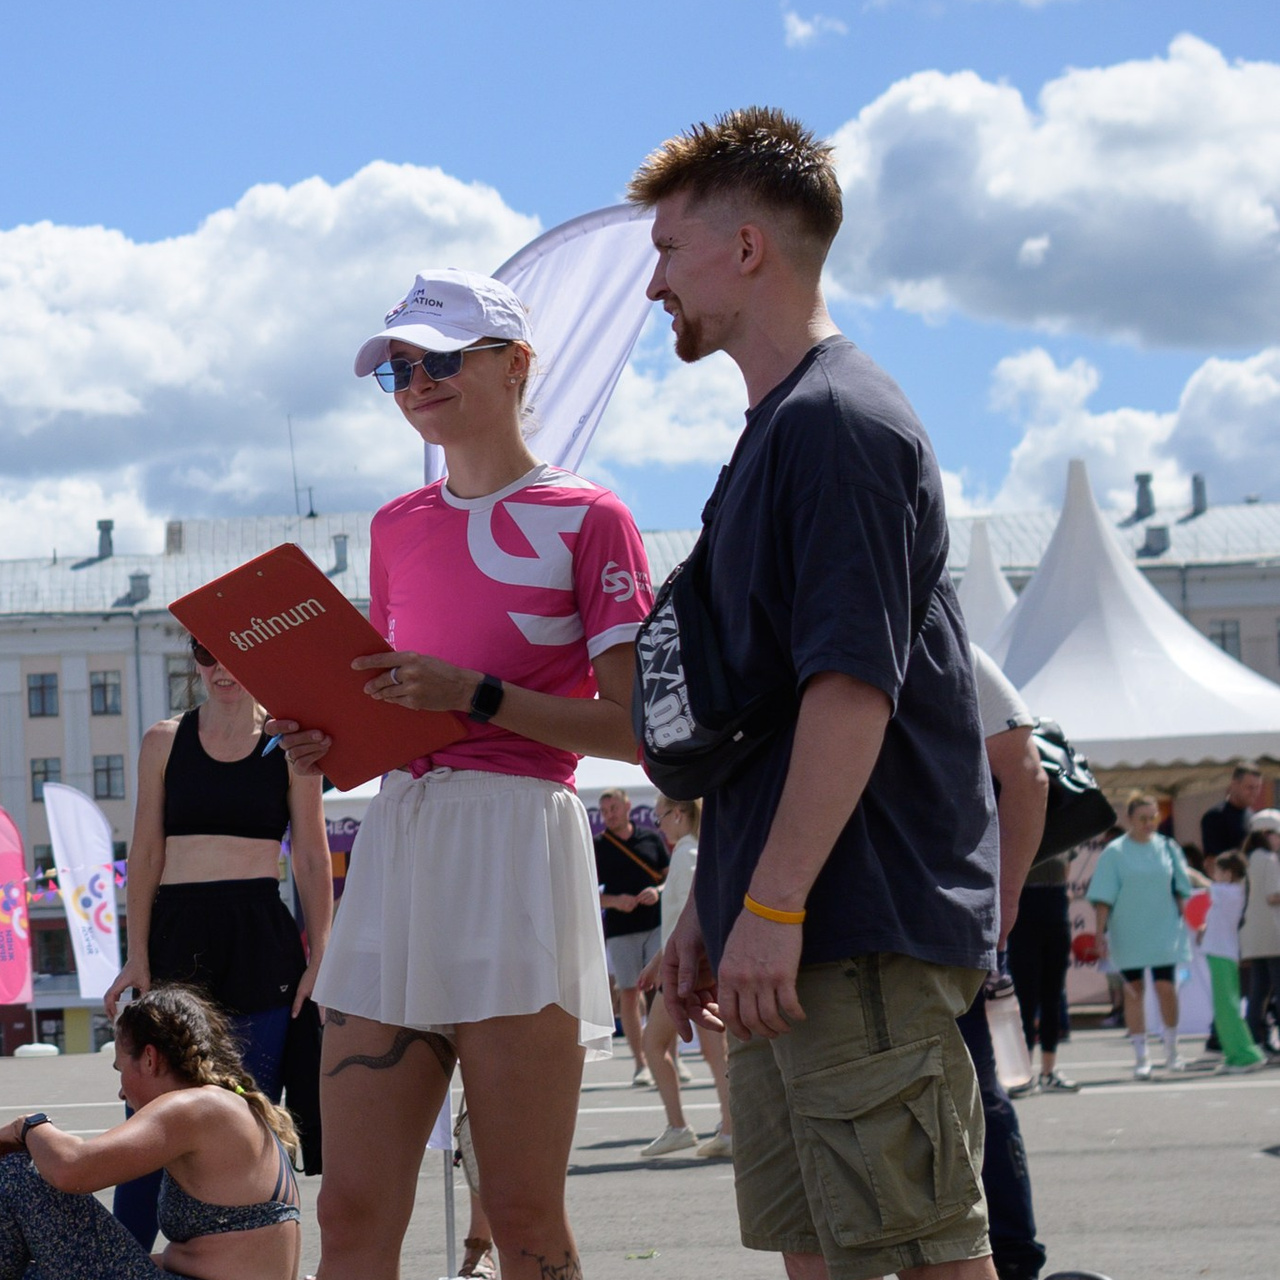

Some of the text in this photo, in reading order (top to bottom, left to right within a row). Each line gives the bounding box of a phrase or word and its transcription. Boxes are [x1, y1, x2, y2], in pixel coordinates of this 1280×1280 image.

[411, 297, 443, 308] ATION
[229, 598, 326, 651] infinum
[648, 693, 693, 748] 08
